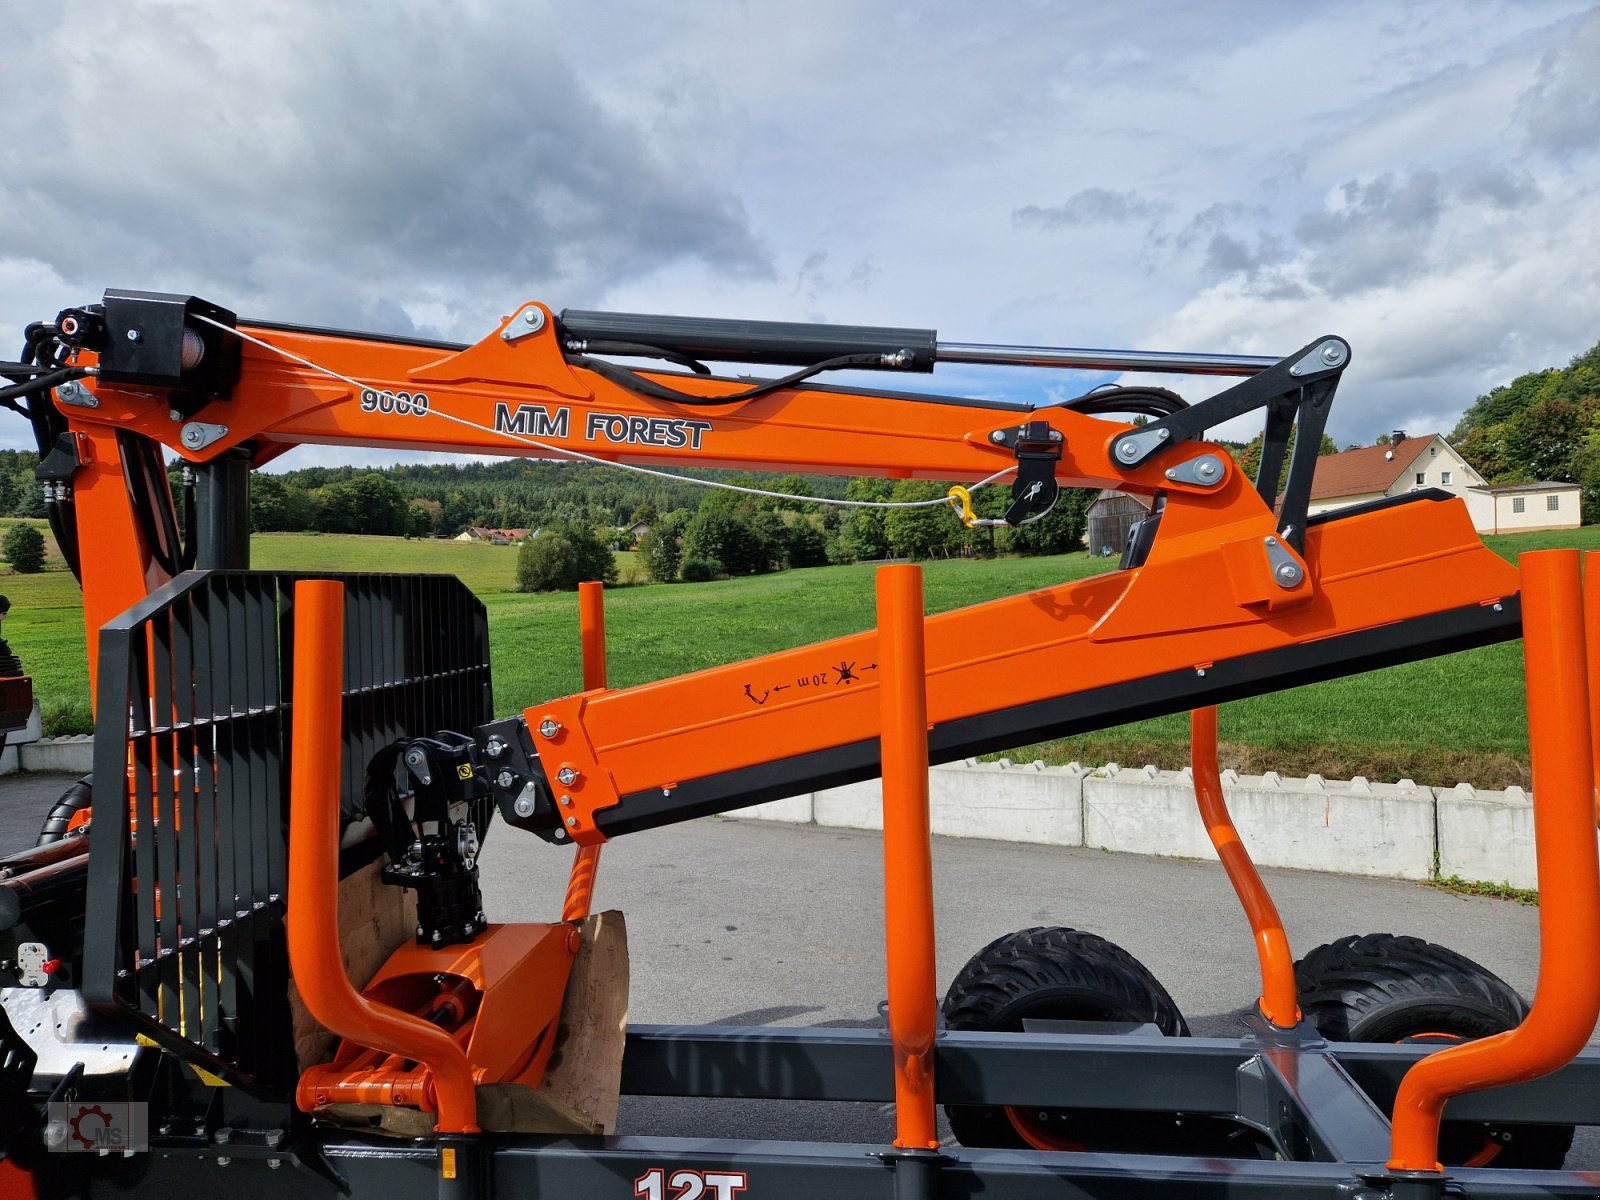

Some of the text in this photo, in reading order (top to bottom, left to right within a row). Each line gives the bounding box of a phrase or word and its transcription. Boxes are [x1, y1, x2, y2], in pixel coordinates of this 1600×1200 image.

[360, 389, 429, 417] 9000
[495, 402, 713, 450] MTM FOREST
[797, 672, 828, 687] 20 m
[634, 1168, 747, 1200] 12T
